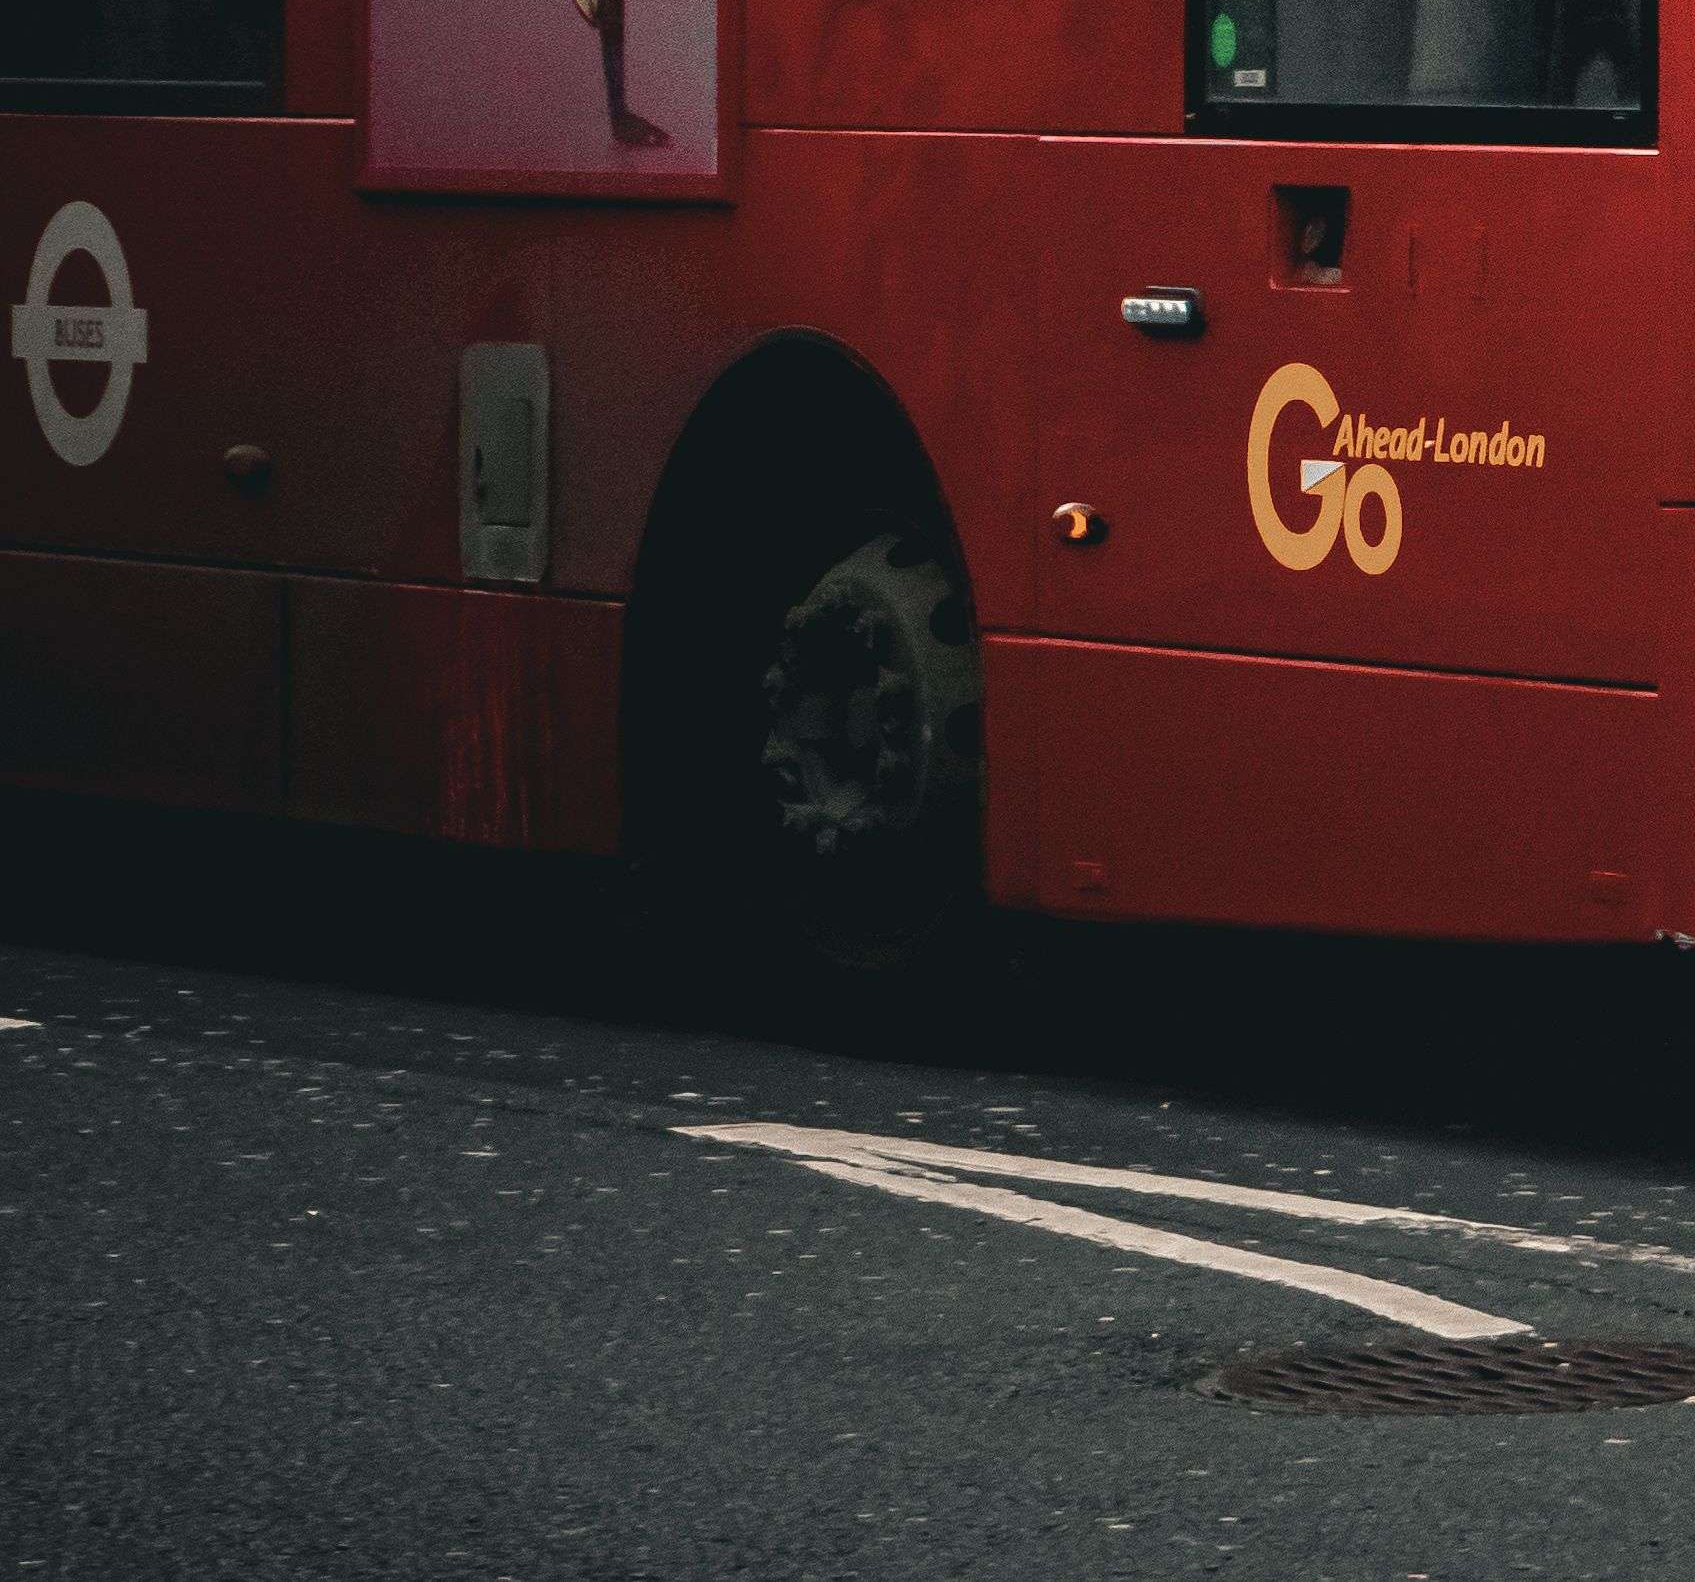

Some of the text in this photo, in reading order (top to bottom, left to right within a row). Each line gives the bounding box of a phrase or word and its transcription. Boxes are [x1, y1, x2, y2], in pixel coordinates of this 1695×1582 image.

[55, 318, 104, 348] BUSES
[1247, 361, 1546, 576] Go Ahead-London
